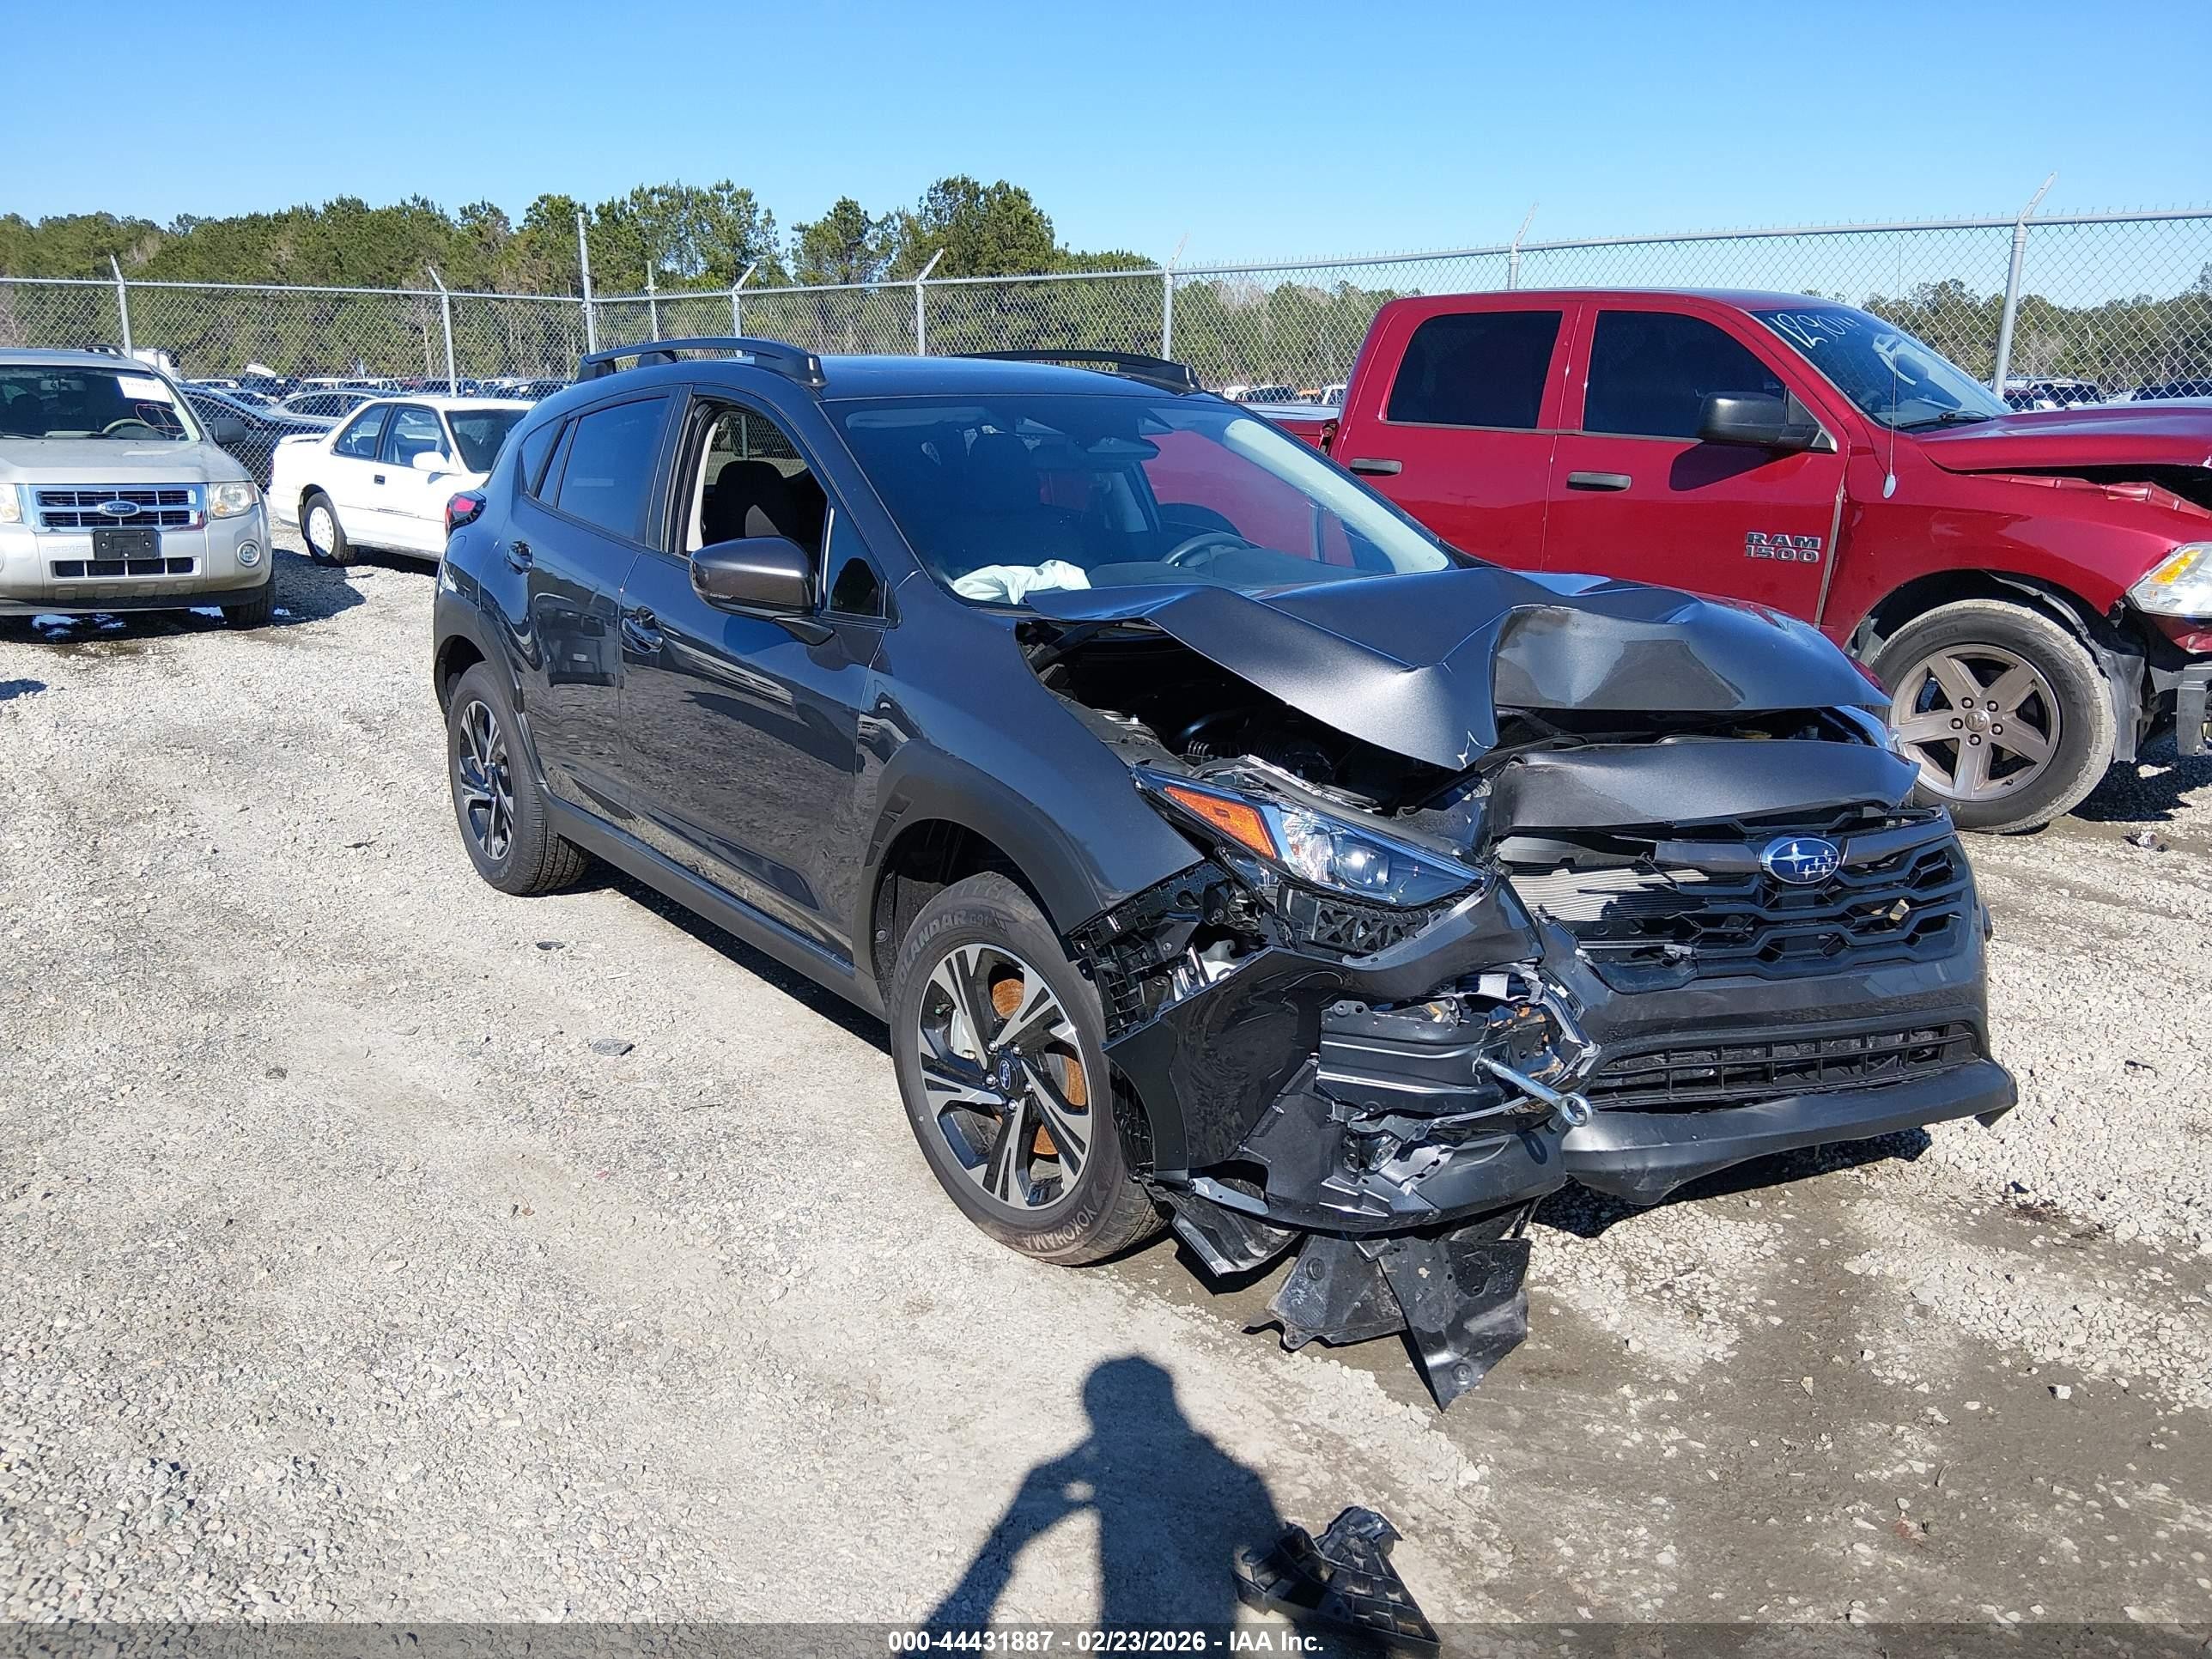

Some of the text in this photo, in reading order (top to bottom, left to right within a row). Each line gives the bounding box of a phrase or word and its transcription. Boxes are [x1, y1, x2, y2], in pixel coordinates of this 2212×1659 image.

[1746, 532, 1821, 550] RAM
[1745, 544, 1820, 563] 1500
[1024, 1204, 1098, 1250] YOKOHAMA
